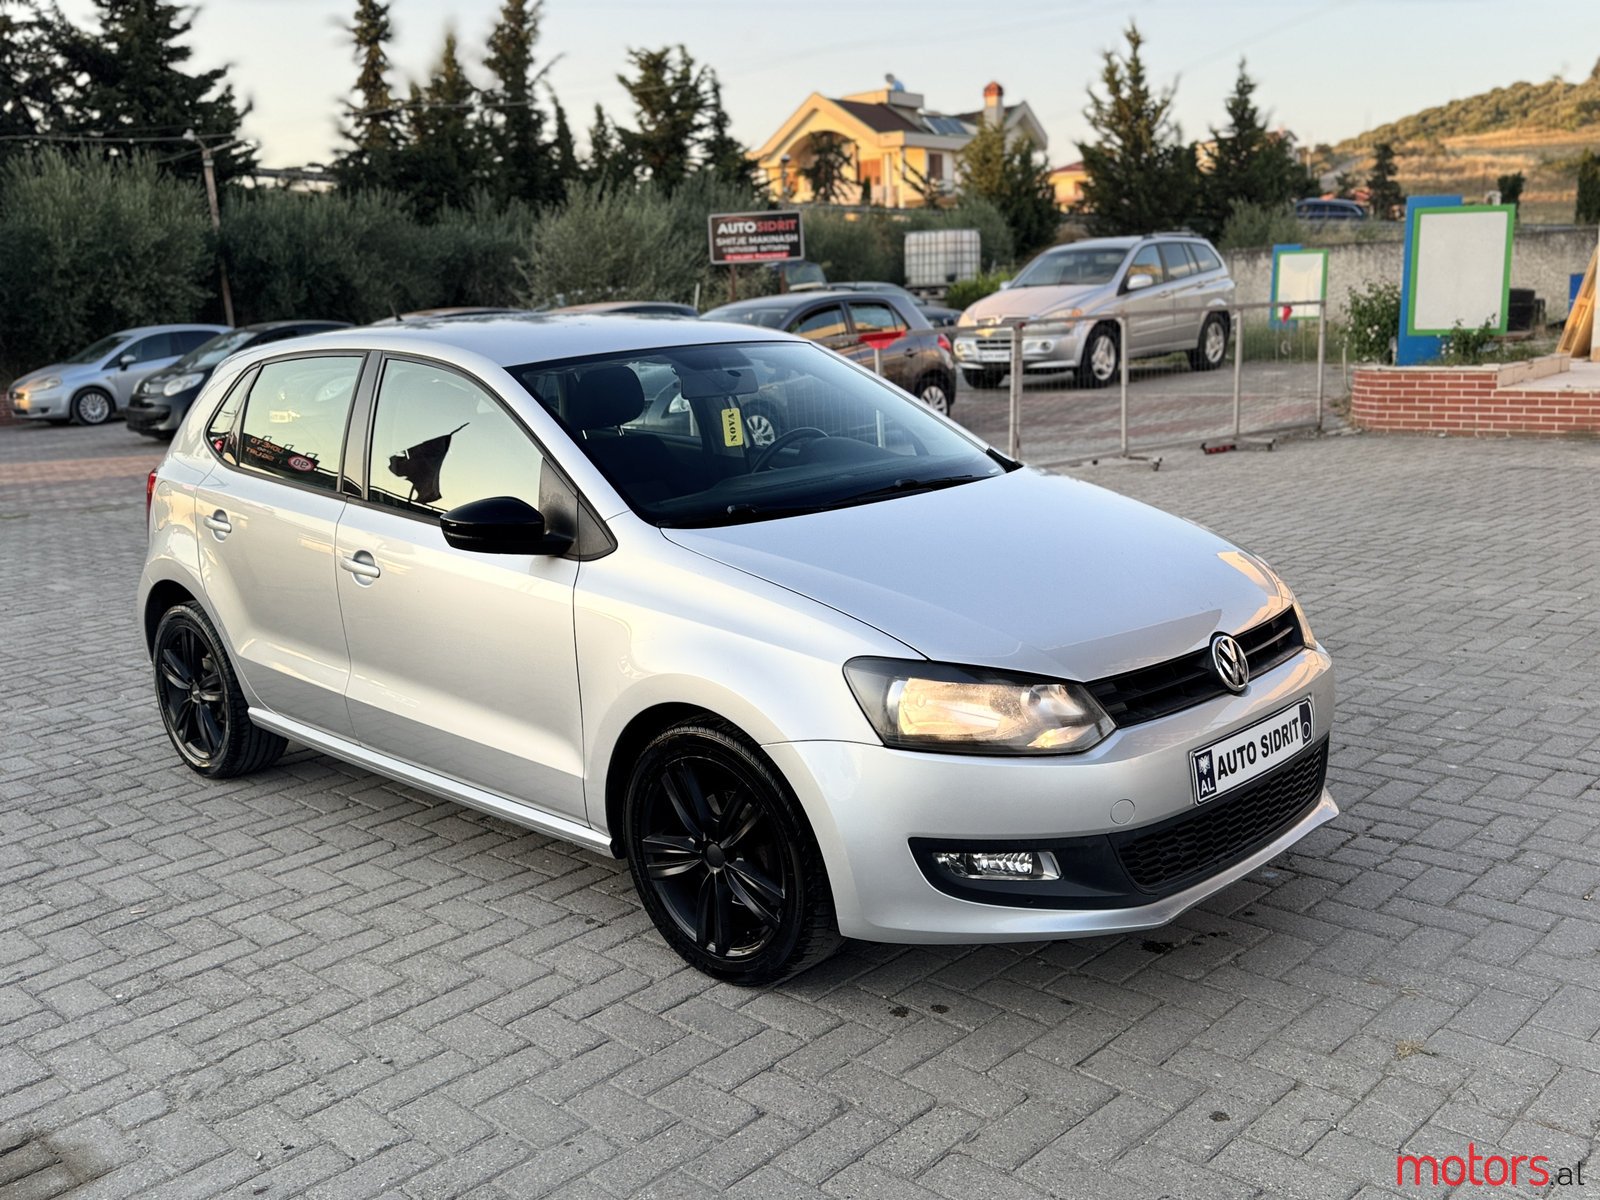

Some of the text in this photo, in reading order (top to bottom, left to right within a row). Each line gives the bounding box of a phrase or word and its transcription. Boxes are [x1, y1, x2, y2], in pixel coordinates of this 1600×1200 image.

[717, 219, 797, 235] AUTO SIDRIT
[727, 412, 738, 442] NOVA
[1217, 717, 1299, 781] AUTO SIDRIT
[1201, 777, 1215, 796] AL
